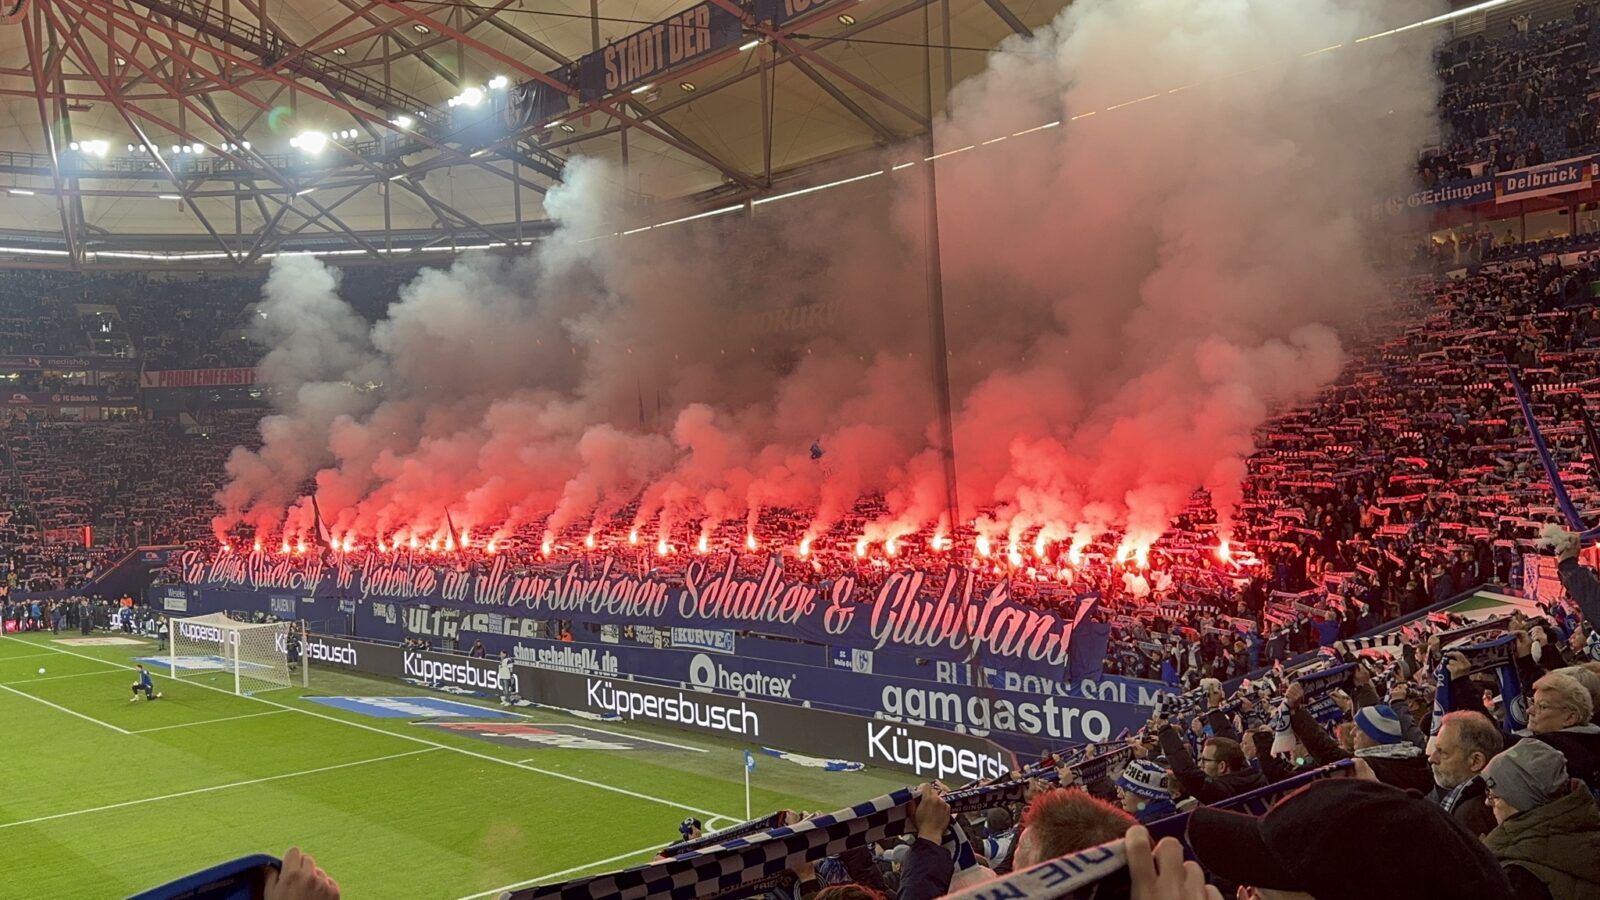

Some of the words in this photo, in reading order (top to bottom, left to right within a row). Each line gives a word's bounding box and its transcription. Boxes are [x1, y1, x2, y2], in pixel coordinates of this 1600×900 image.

[604, 24, 666, 91] STADT
[668, 3, 712, 63] DER
[158, 366, 257, 386] PROBLEMFENSTE
[442, 569, 470, 600] an
[508, 556, 669, 617] verstorbenen
[678, 551, 816, 625] Schalker
[823, 576, 855, 634] &
[179, 622, 241, 645] Küppersbuch
[404, 651, 519, 693] Küppersbush
[718, 663, 792, 699] heatrex
[587, 678, 759, 736] Küppersbusch
[882, 685, 1111, 742] ggmgastro
